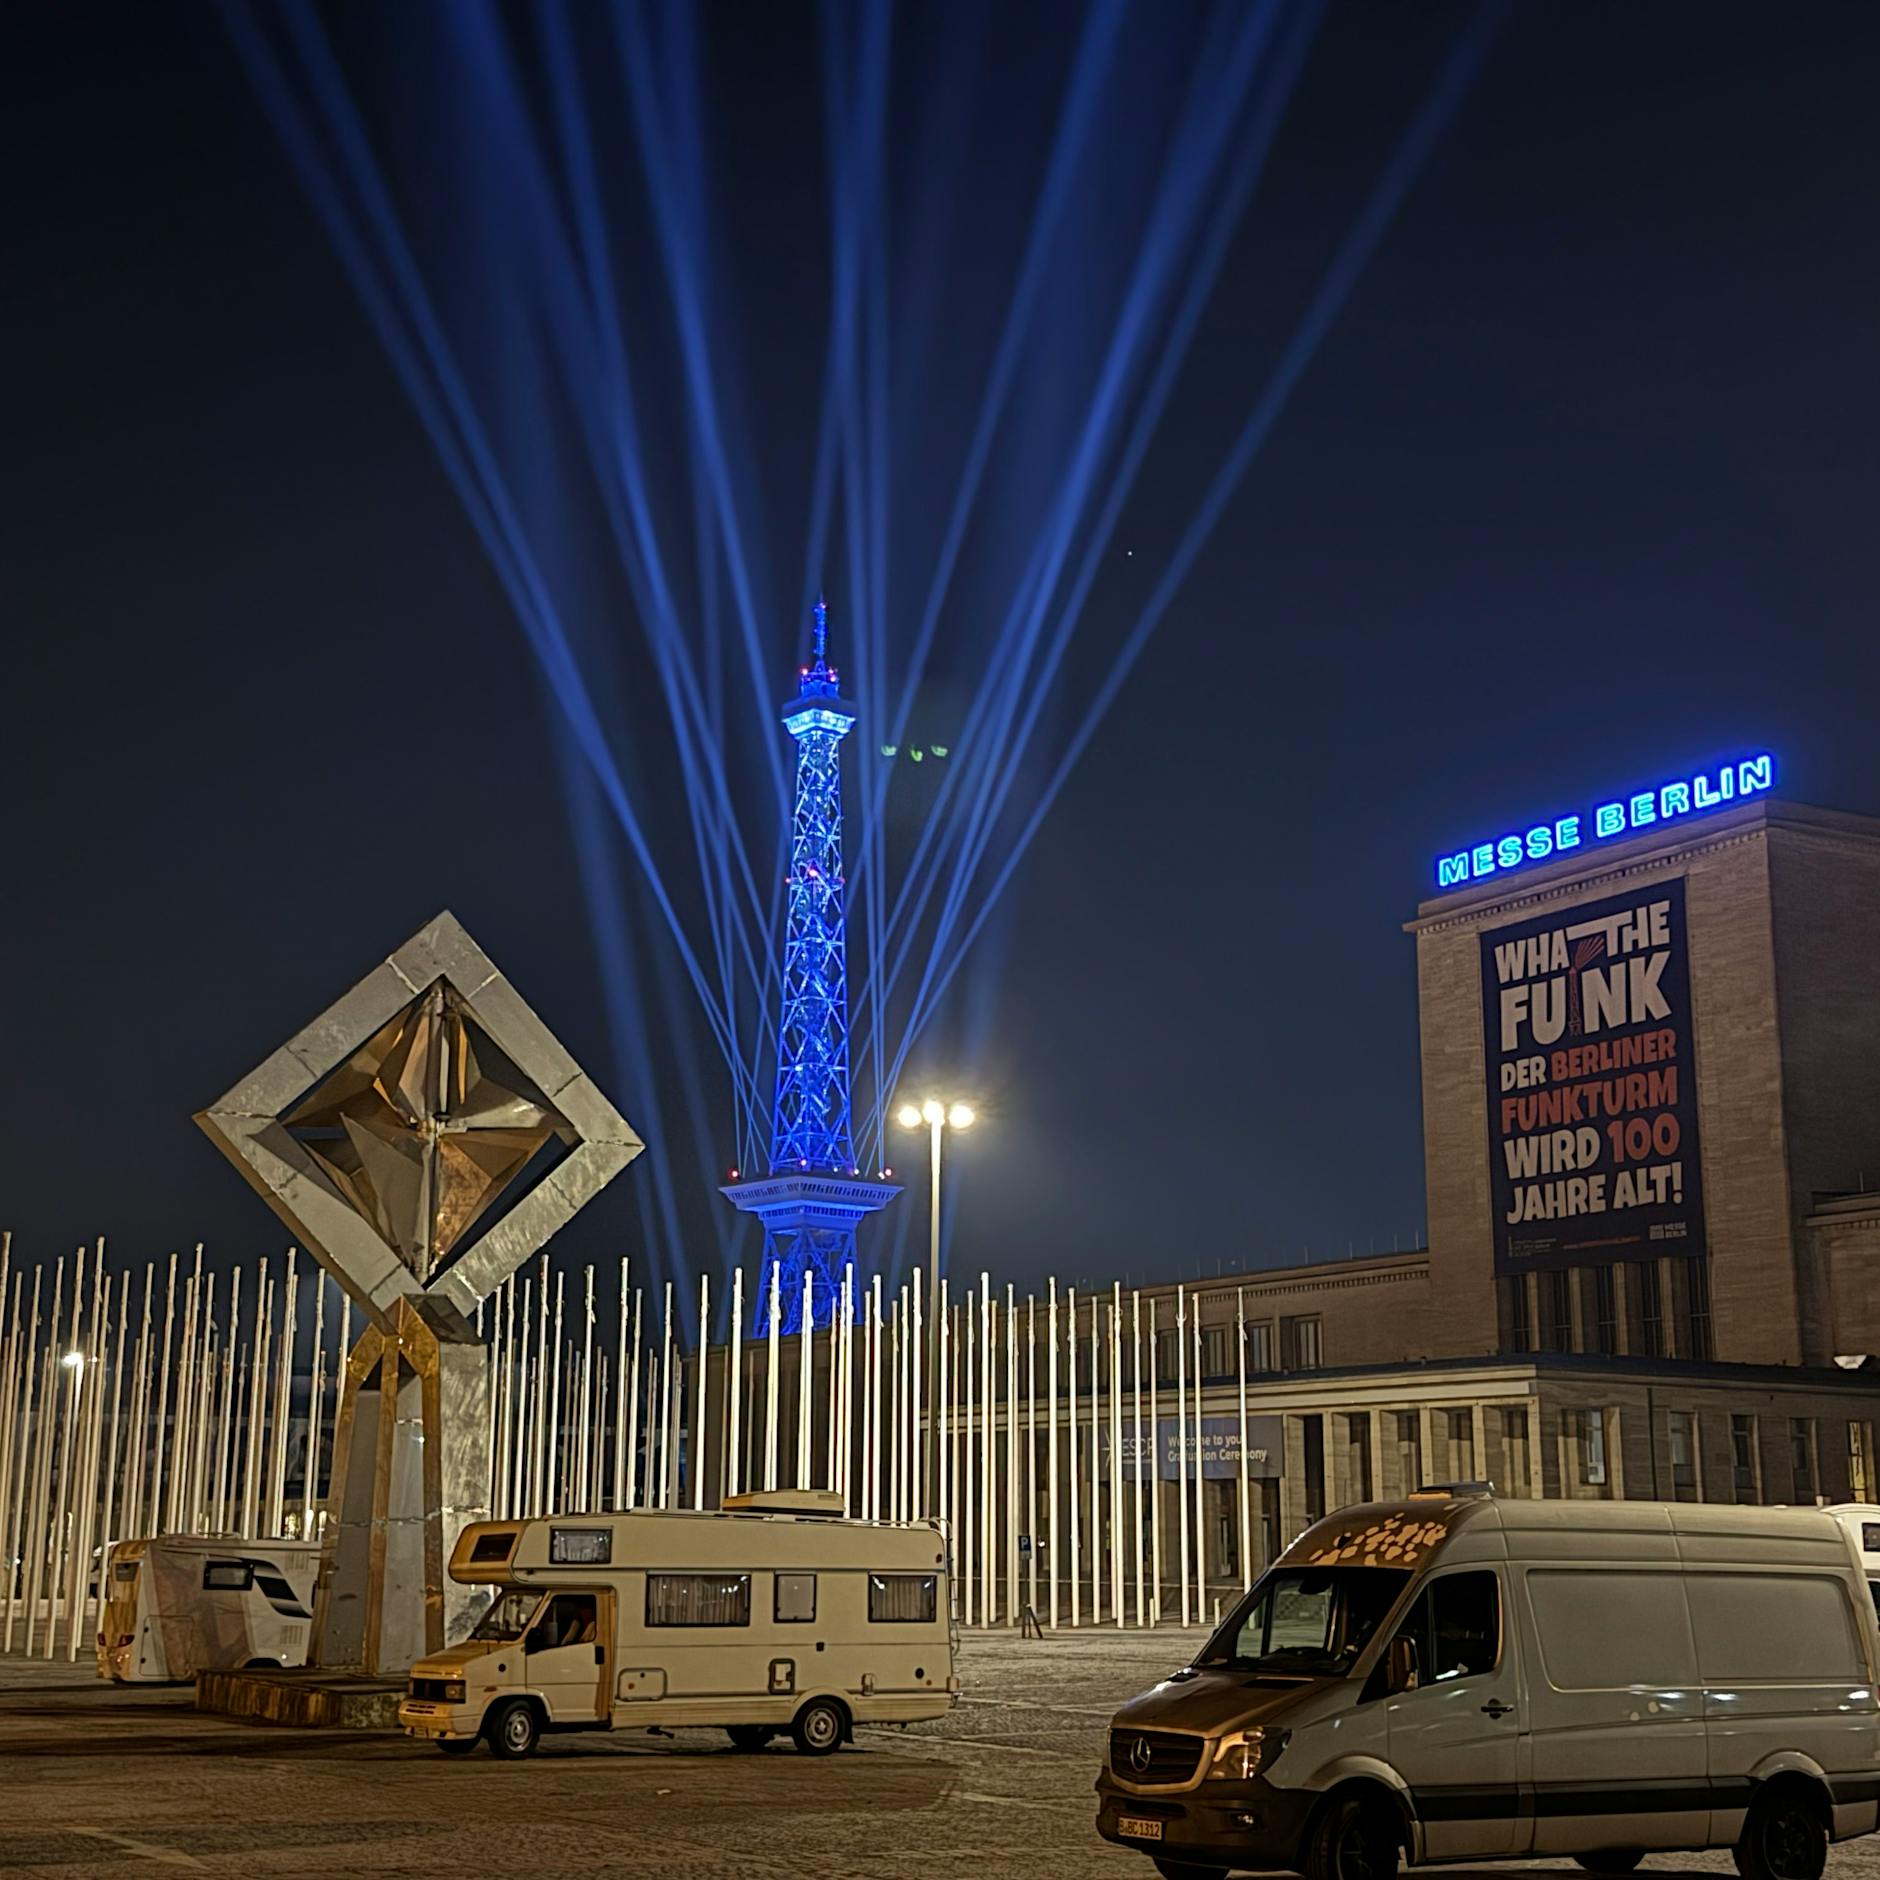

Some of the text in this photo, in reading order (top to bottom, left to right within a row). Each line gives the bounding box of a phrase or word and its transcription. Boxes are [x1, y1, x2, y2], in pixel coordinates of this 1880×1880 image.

[1438, 755, 1772, 886] MESSE BERLIN
[1500, 951, 1672, 1052] FUNK
[1500, 1028, 1677, 1092] DER BERLINER
[1502, 1066, 1678, 1134] FUNKTURM
[1504, 1112, 1681, 1180] WIRD 100
[1506, 1162, 1682, 1225] JAHRE ALT!
[1213, 1434, 1223, 1446] to
[1219, 1448, 1267, 1462] Cereony
[1021, 1536, 1029, 1550] P
